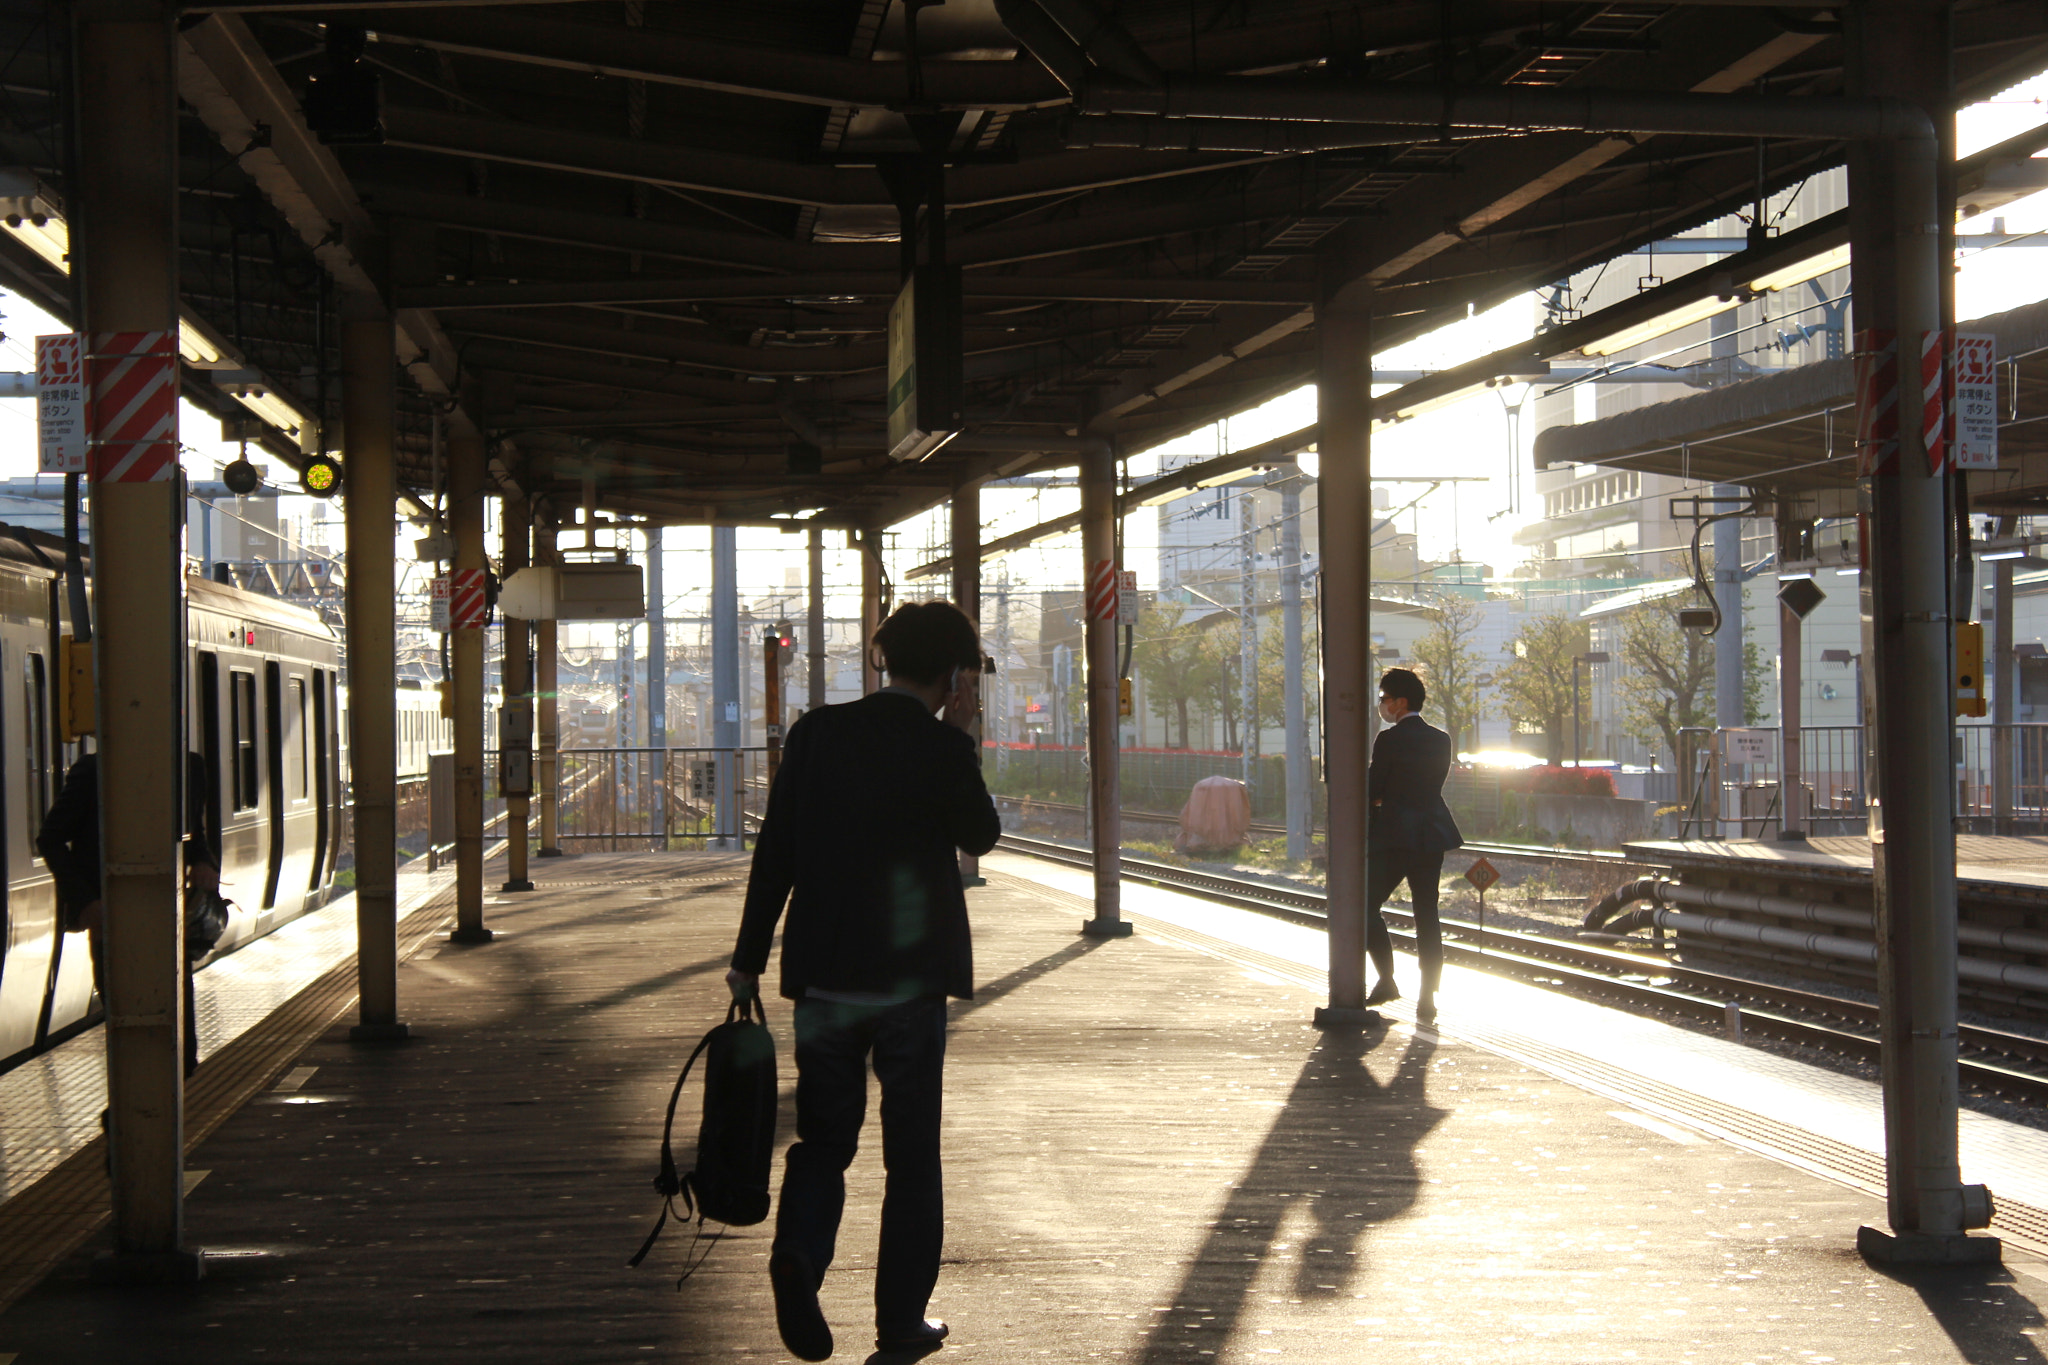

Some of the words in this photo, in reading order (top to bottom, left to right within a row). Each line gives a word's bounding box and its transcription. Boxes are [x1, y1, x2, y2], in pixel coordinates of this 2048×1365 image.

[42, 389, 80, 402] 非常停止
[1958, 388, 1992, 401] 非常停止
[42, 405, 70, 417] ボタン
[1967, 403, 1992, 415] ボタン
[57, 447, 64, 467] 5
[1961, 443, 1968, 463] 6
